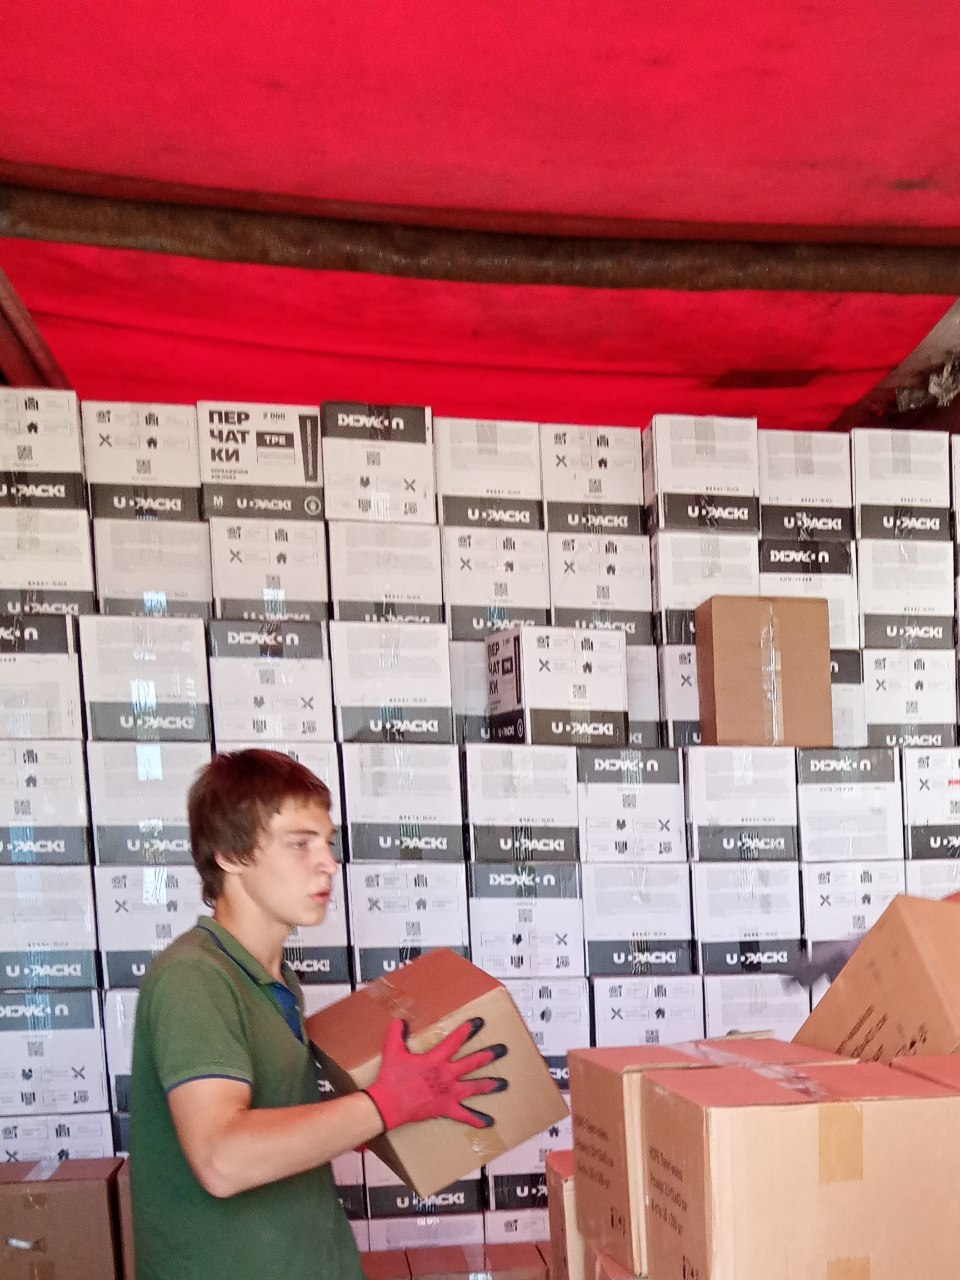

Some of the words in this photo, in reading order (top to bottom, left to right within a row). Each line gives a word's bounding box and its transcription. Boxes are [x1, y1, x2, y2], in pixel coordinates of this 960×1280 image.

[208, 409, 250, 426] ПЕР
[208, 428, 250, 444] ЧАТ
[210, 447, 240, 463] КИ
